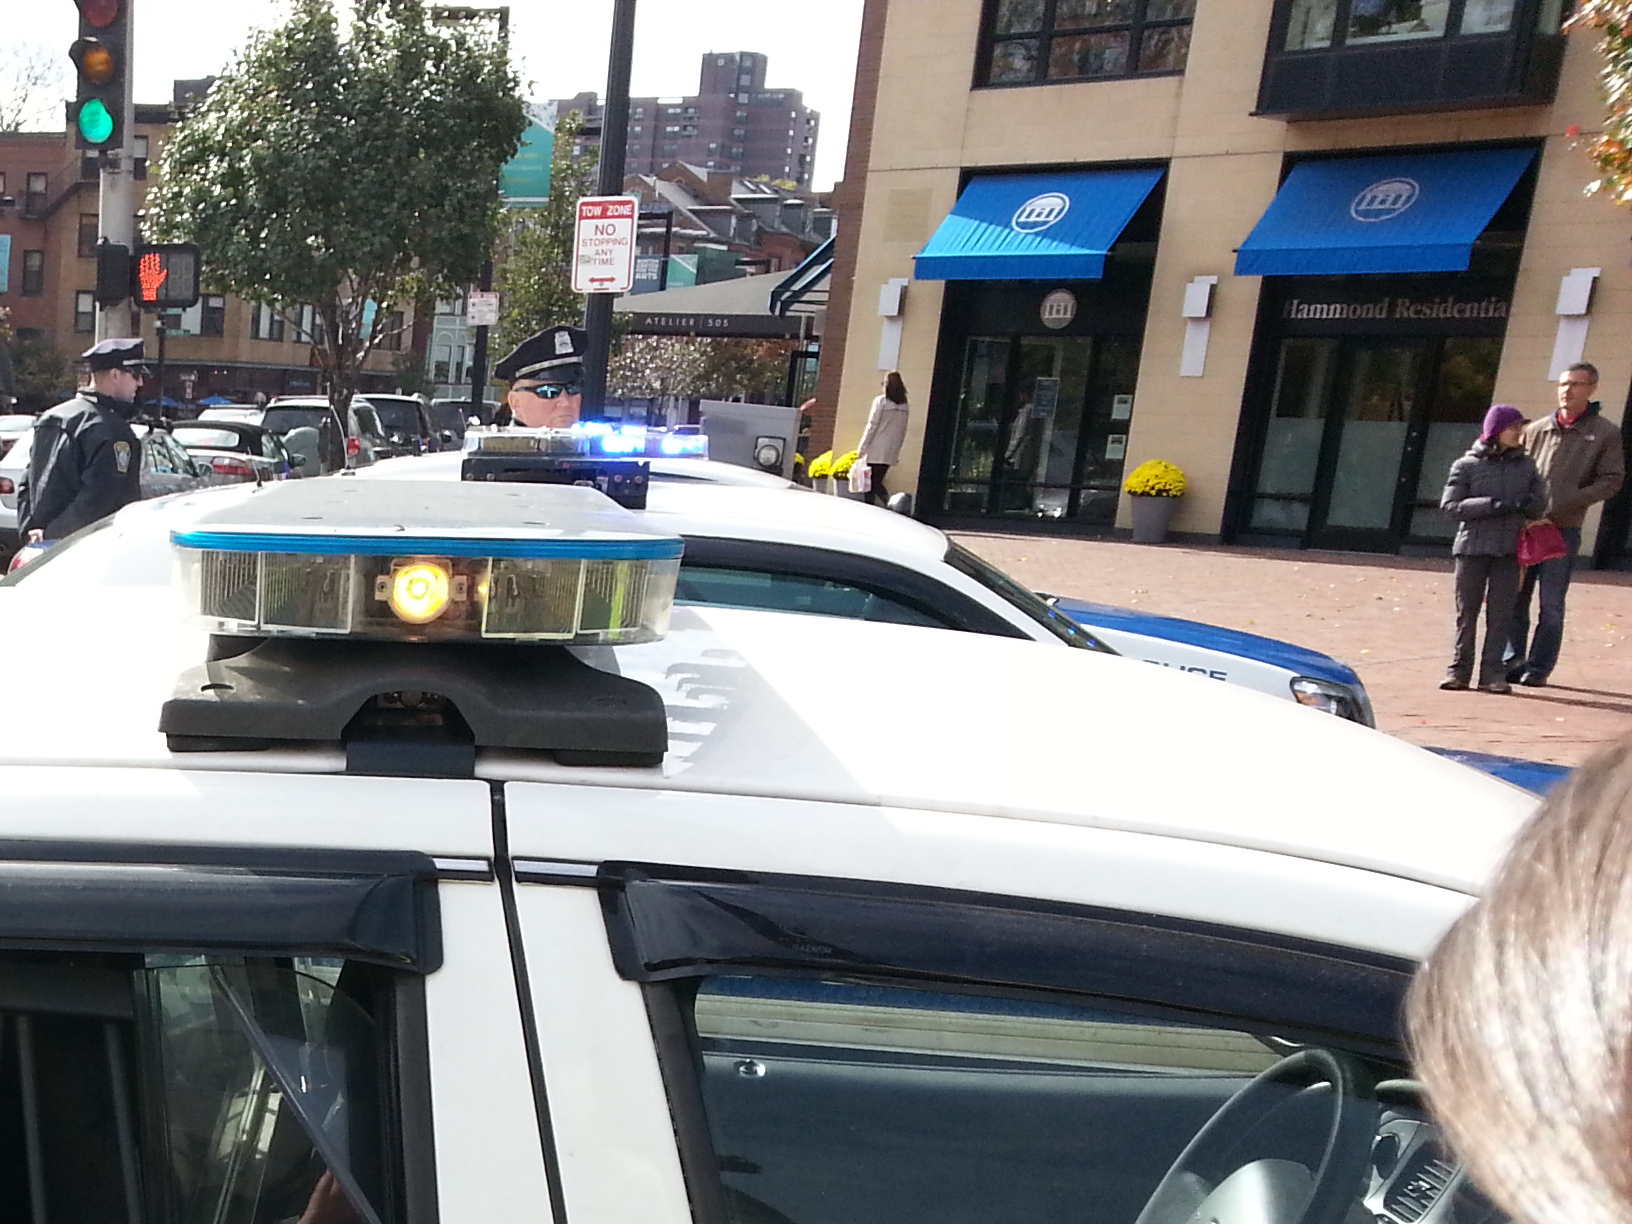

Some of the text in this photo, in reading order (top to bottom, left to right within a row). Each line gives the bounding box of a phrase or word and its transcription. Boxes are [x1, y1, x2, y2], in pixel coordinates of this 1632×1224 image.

[581, 205, 632, 216] TOW ZONE
[594, 223, 616, 236] NO
[581, 237, 628, 247] STOPPING
[1283, 297, 1389, 319] Hammond
[645, 317, 729, 327] ATELIER 505
